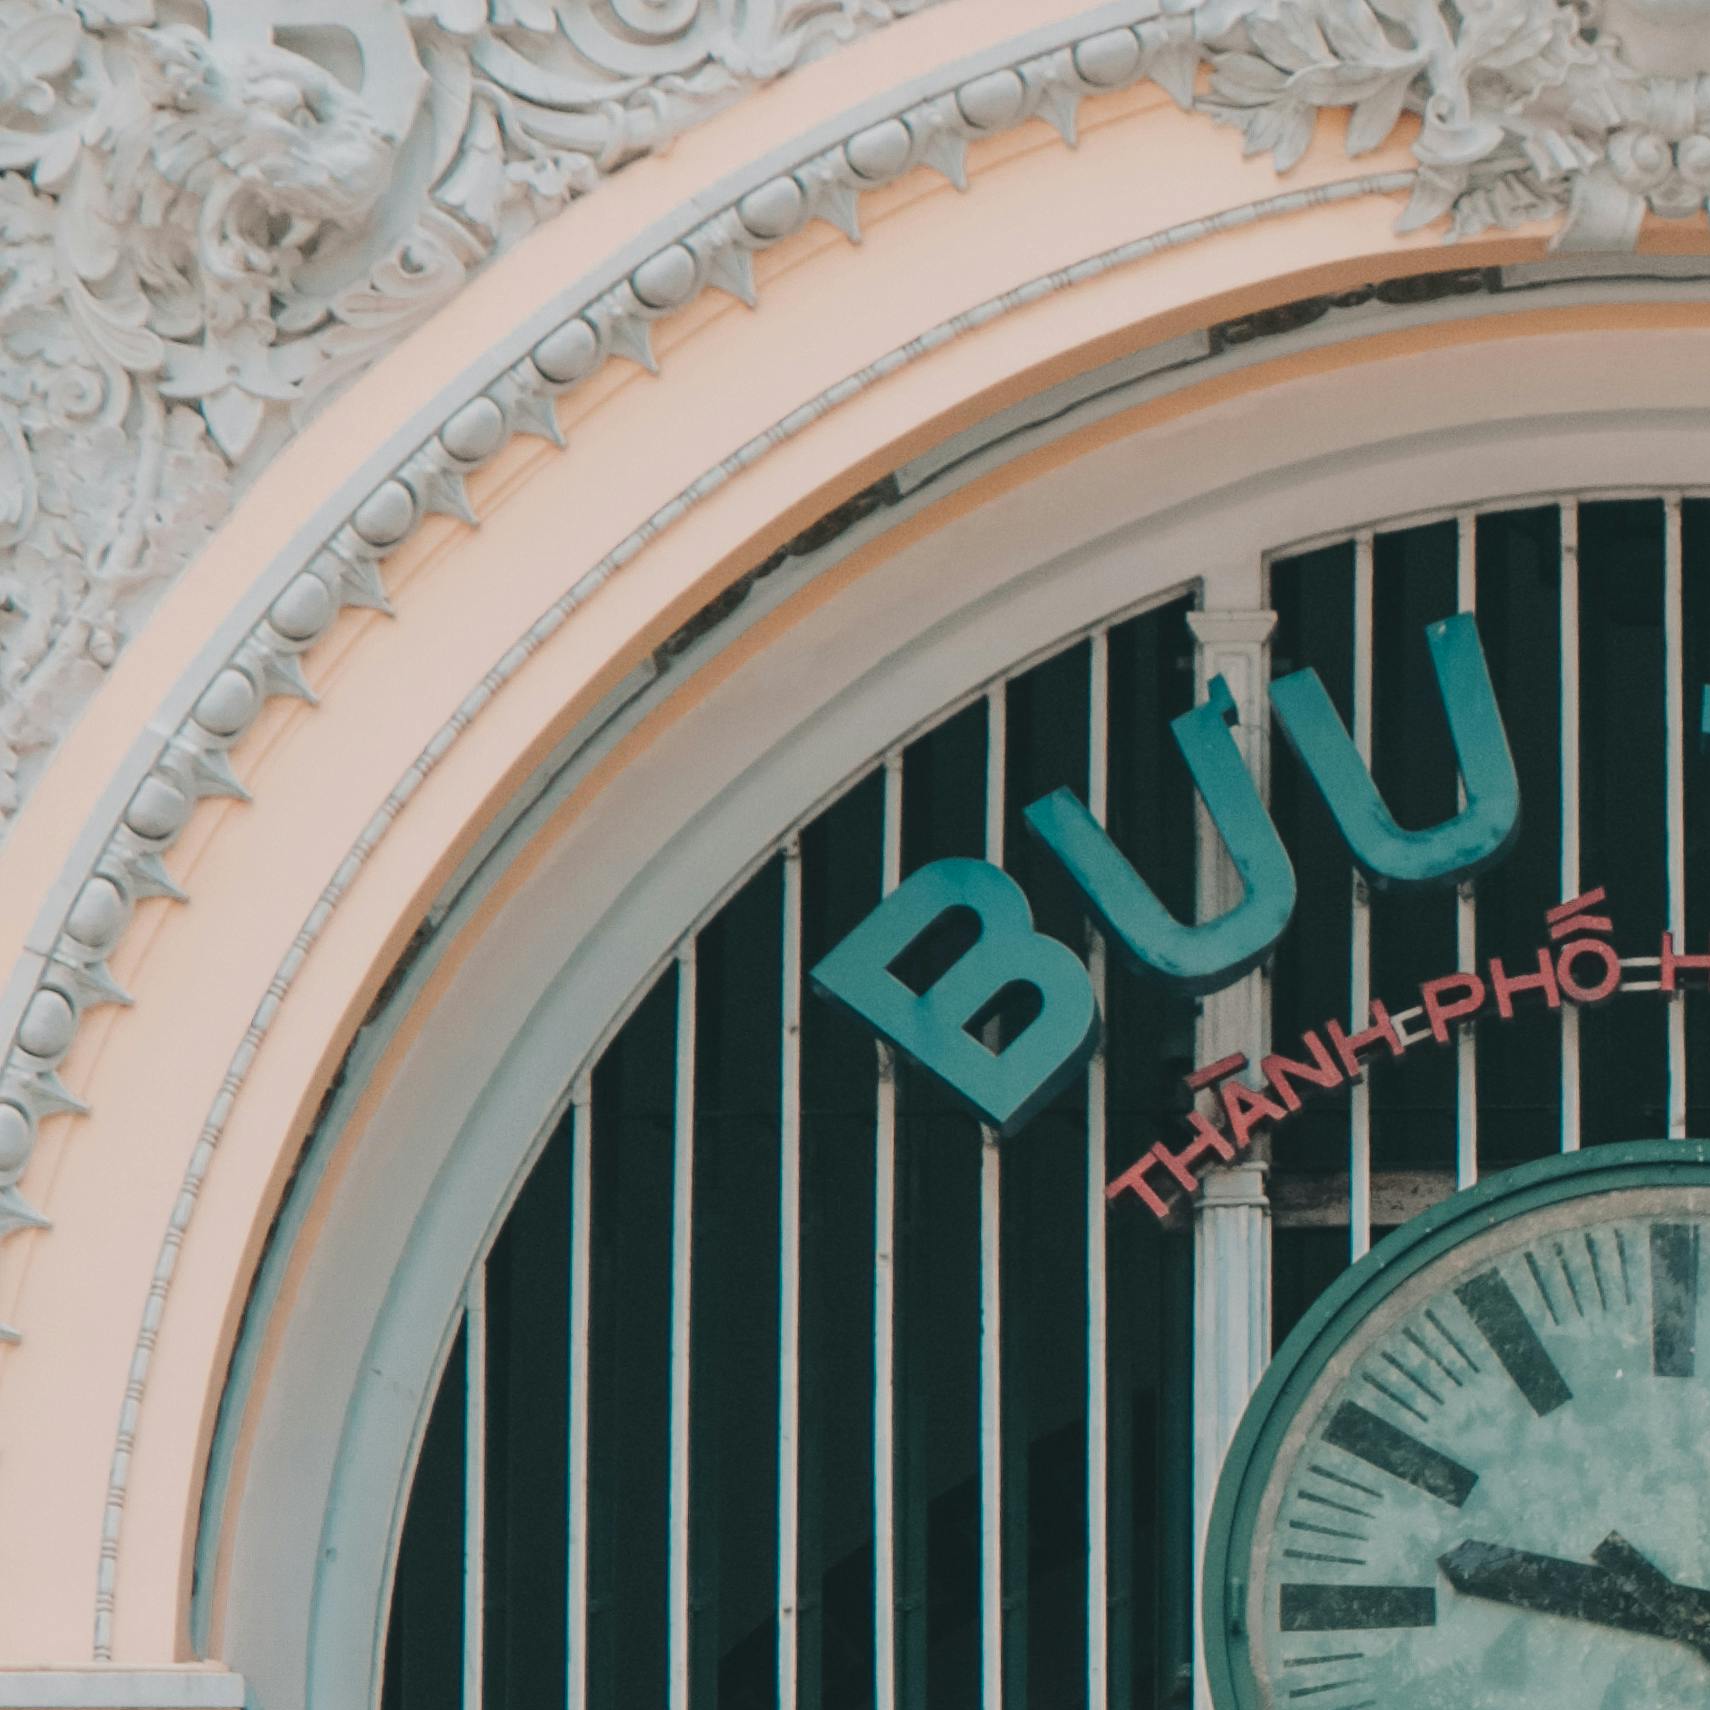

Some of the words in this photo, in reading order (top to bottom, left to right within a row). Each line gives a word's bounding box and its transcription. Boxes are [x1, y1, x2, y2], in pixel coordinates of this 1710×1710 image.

[811, 612, 1520, 1128] BƯU
[1104, 998, 1406, 1220] THÀNH
[1421, 887, 1622, 1044] PHỐ
